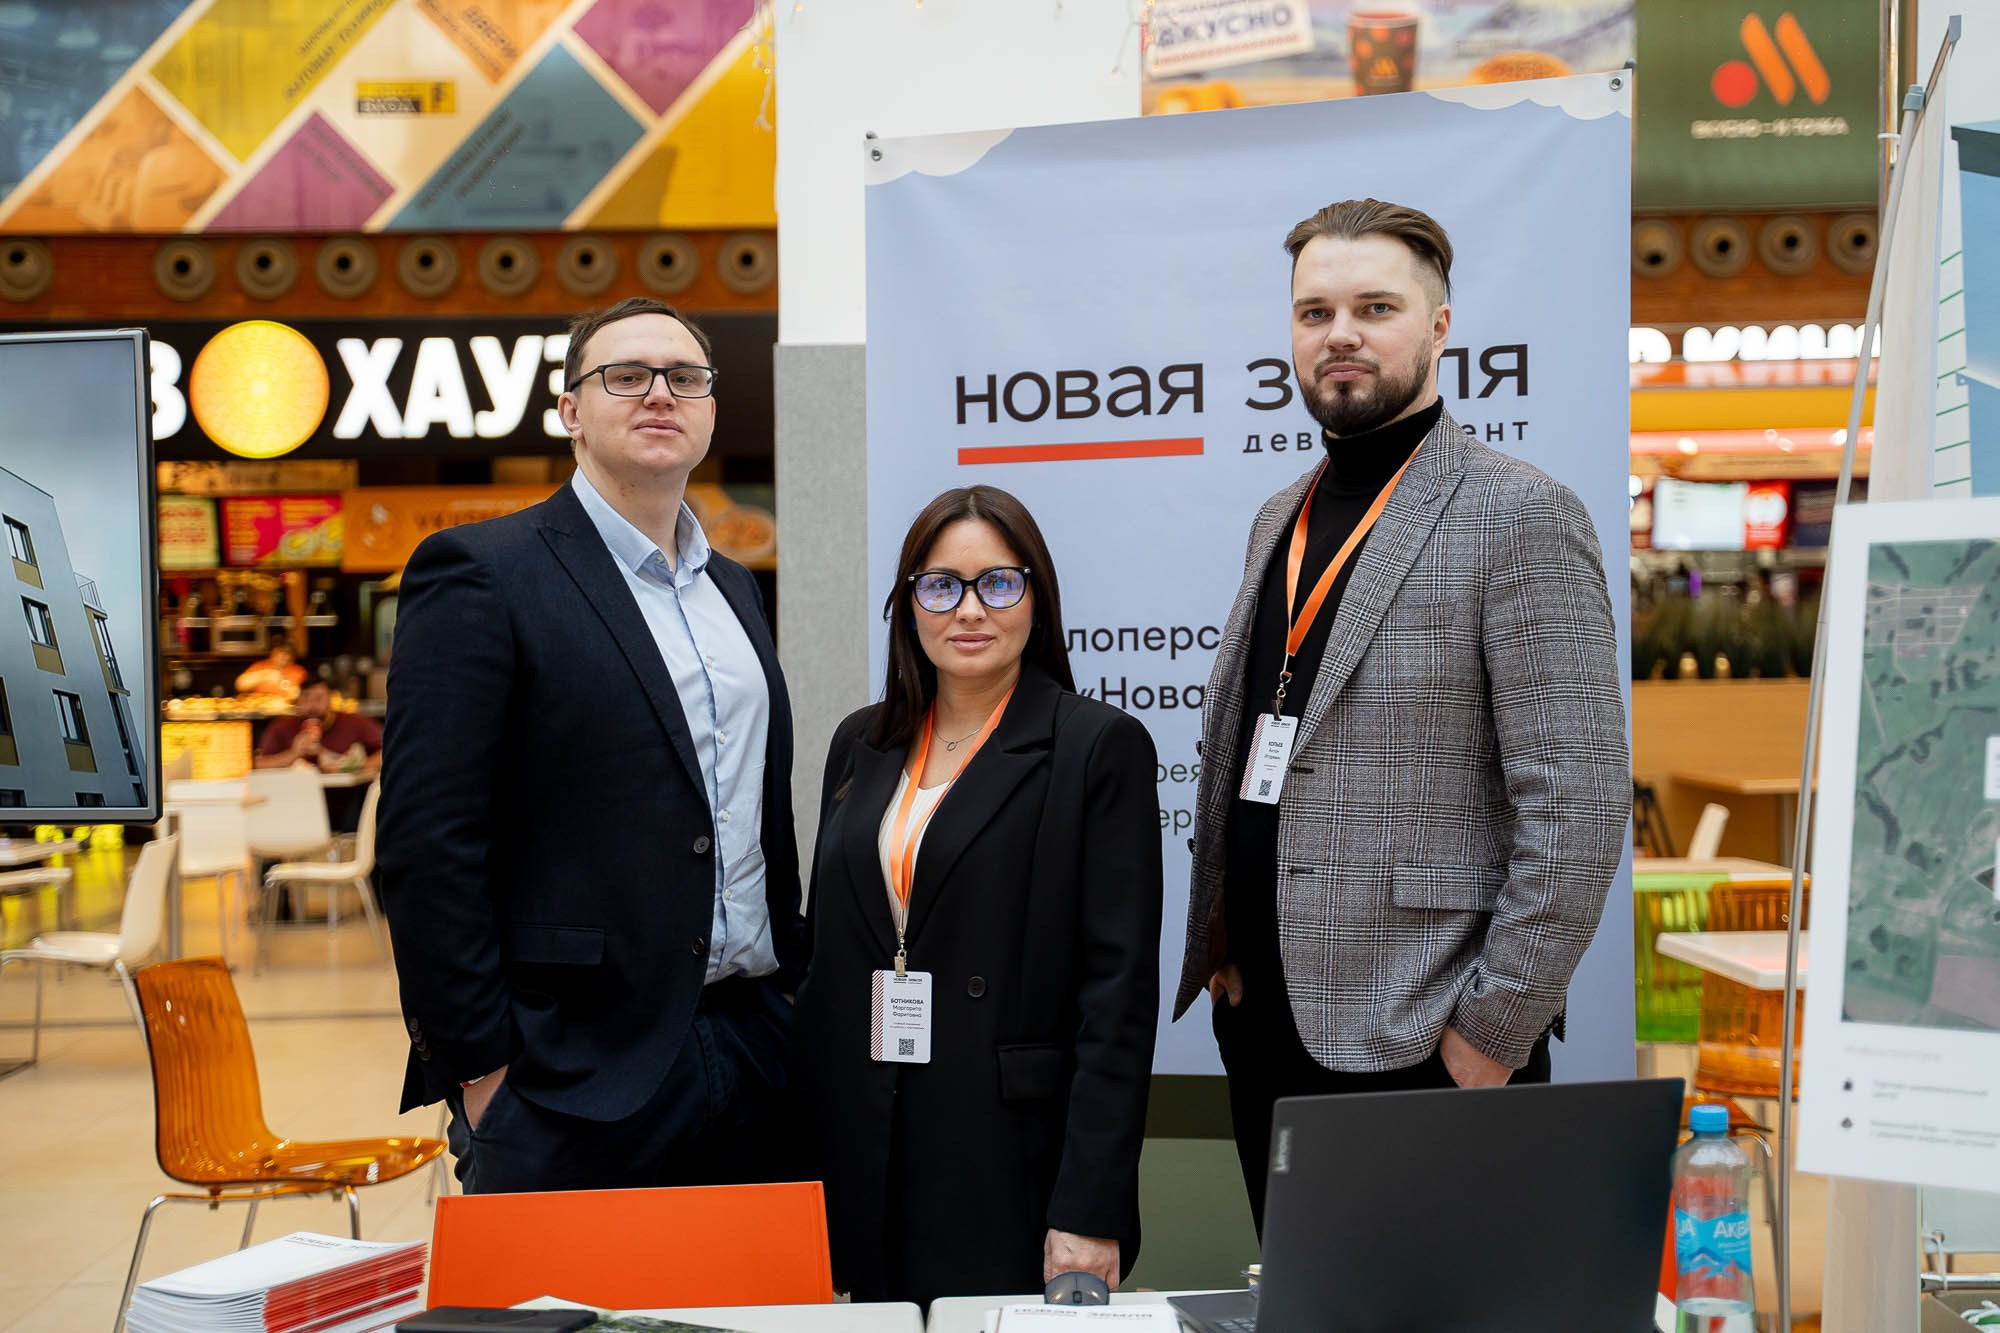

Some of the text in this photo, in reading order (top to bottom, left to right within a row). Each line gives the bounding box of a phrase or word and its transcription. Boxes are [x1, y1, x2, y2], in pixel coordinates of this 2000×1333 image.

[956, 344, 1529, 425] новая зля
[1243, 421, 1529, 454] девент
[1066, 625, 1221, 660] лоперс
[1077, 676, 1206, 710] «Нова
